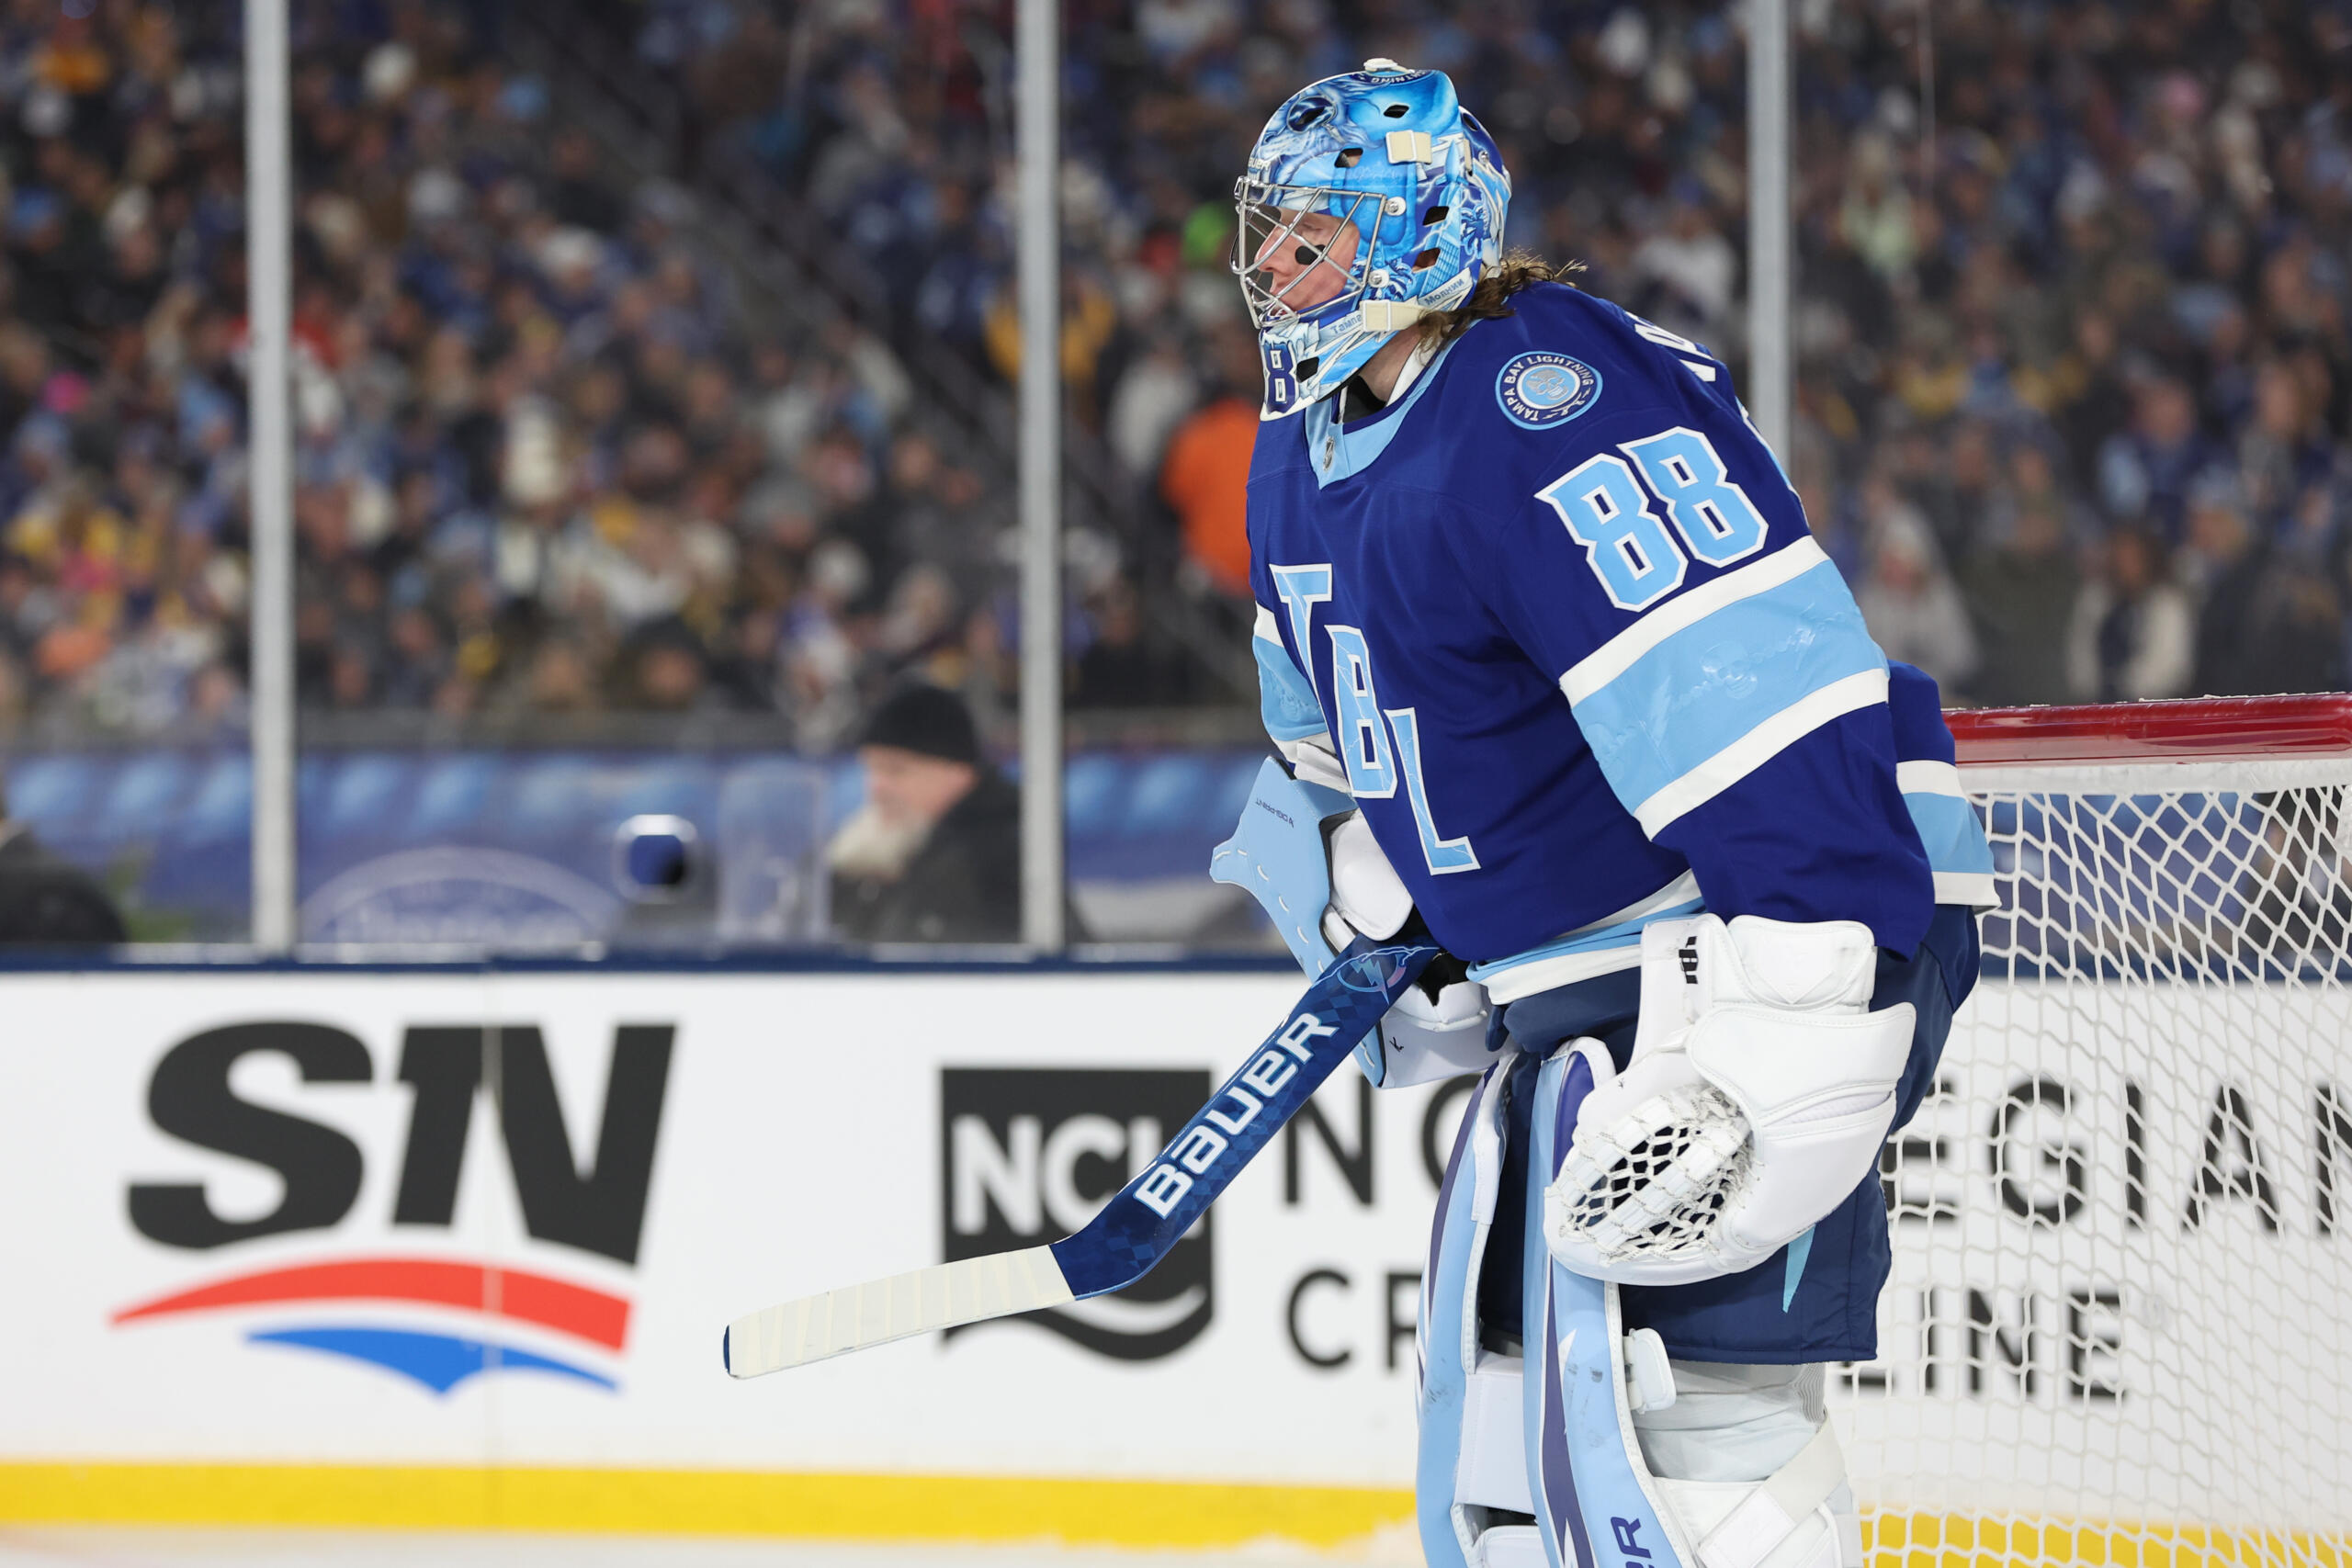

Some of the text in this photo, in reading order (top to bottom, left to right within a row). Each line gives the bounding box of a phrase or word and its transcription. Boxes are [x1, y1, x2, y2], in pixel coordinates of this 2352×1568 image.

[1503, 355, 1595, 422] TAMPA BAY LIGHTNING
[1533, 425, 1770, 613] 88
[126, 1020, 678, 1268] SN
